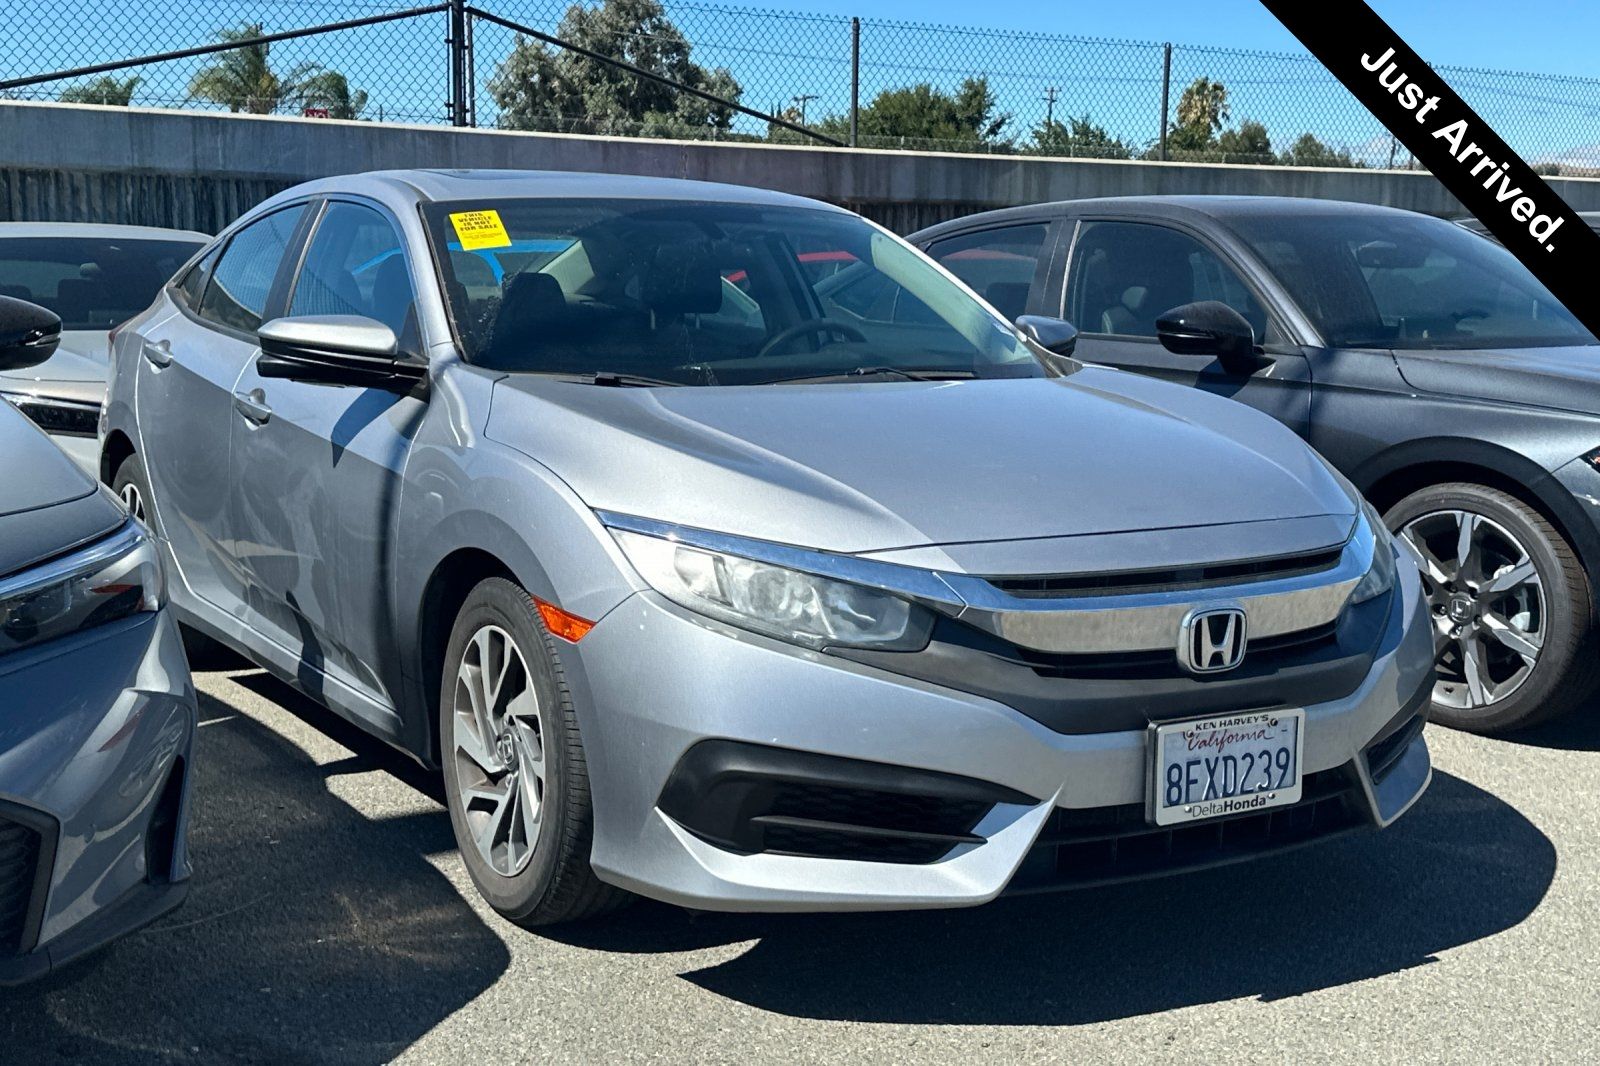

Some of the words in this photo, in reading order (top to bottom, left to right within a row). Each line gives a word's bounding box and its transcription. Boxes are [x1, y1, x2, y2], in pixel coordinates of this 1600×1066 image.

[1195, 720, 1217, 731] KEN
[1219, 714, 1269, 728] HARVEY'S
[1187, 728, 1275, 754] California
[1166, 746, 1290, 807] 8FXD239
